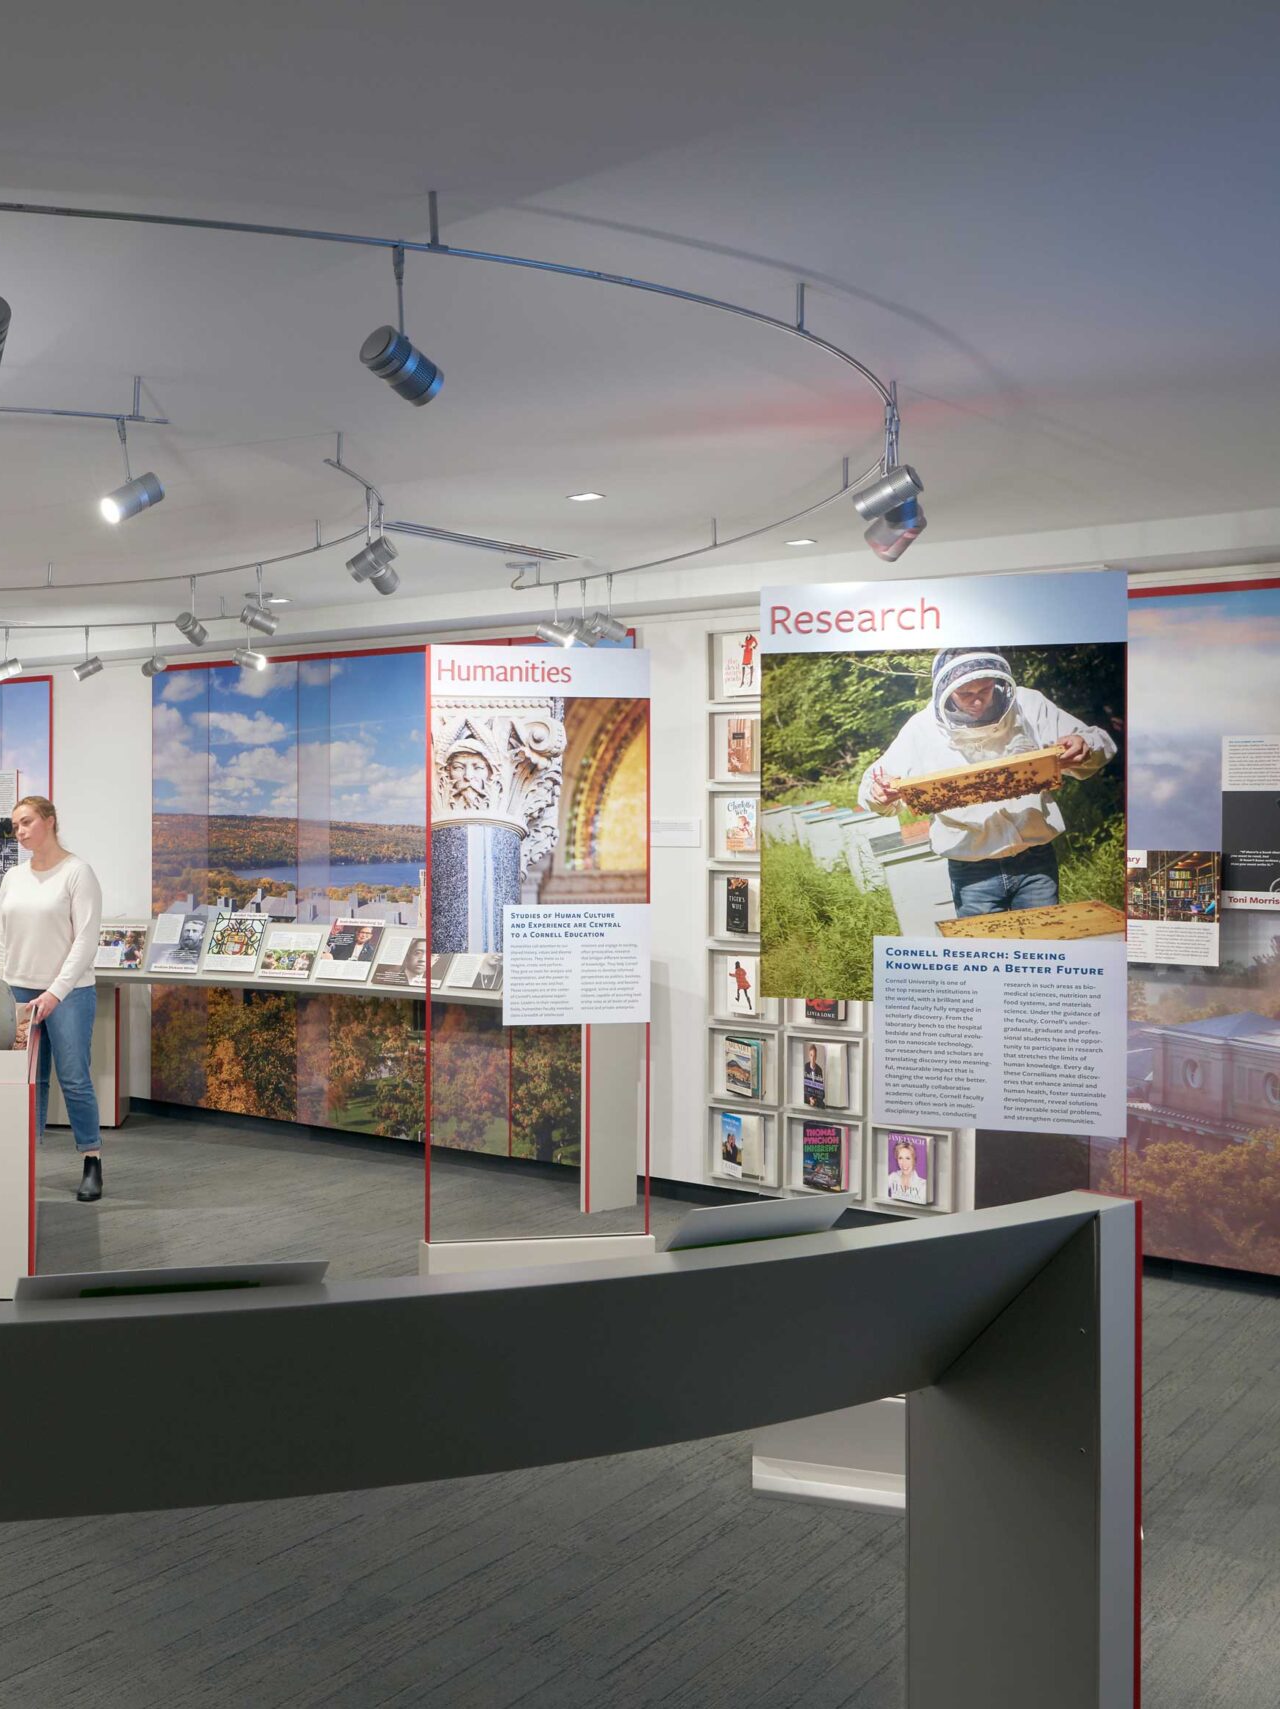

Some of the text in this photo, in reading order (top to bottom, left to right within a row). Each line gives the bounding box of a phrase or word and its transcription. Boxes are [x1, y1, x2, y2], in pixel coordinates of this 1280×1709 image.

[770, 597, 940, 634] Research
[437, 659, 572, 683] Humanities
[886, 948, 1066, 960] CORNELL RESEARCH: SEEKING
[886, 961, 958, 971] KNOWLEDGE
[1005, 964, 1052, 974] BETTER
[1057, 965, 1104, 976] FUTURE
